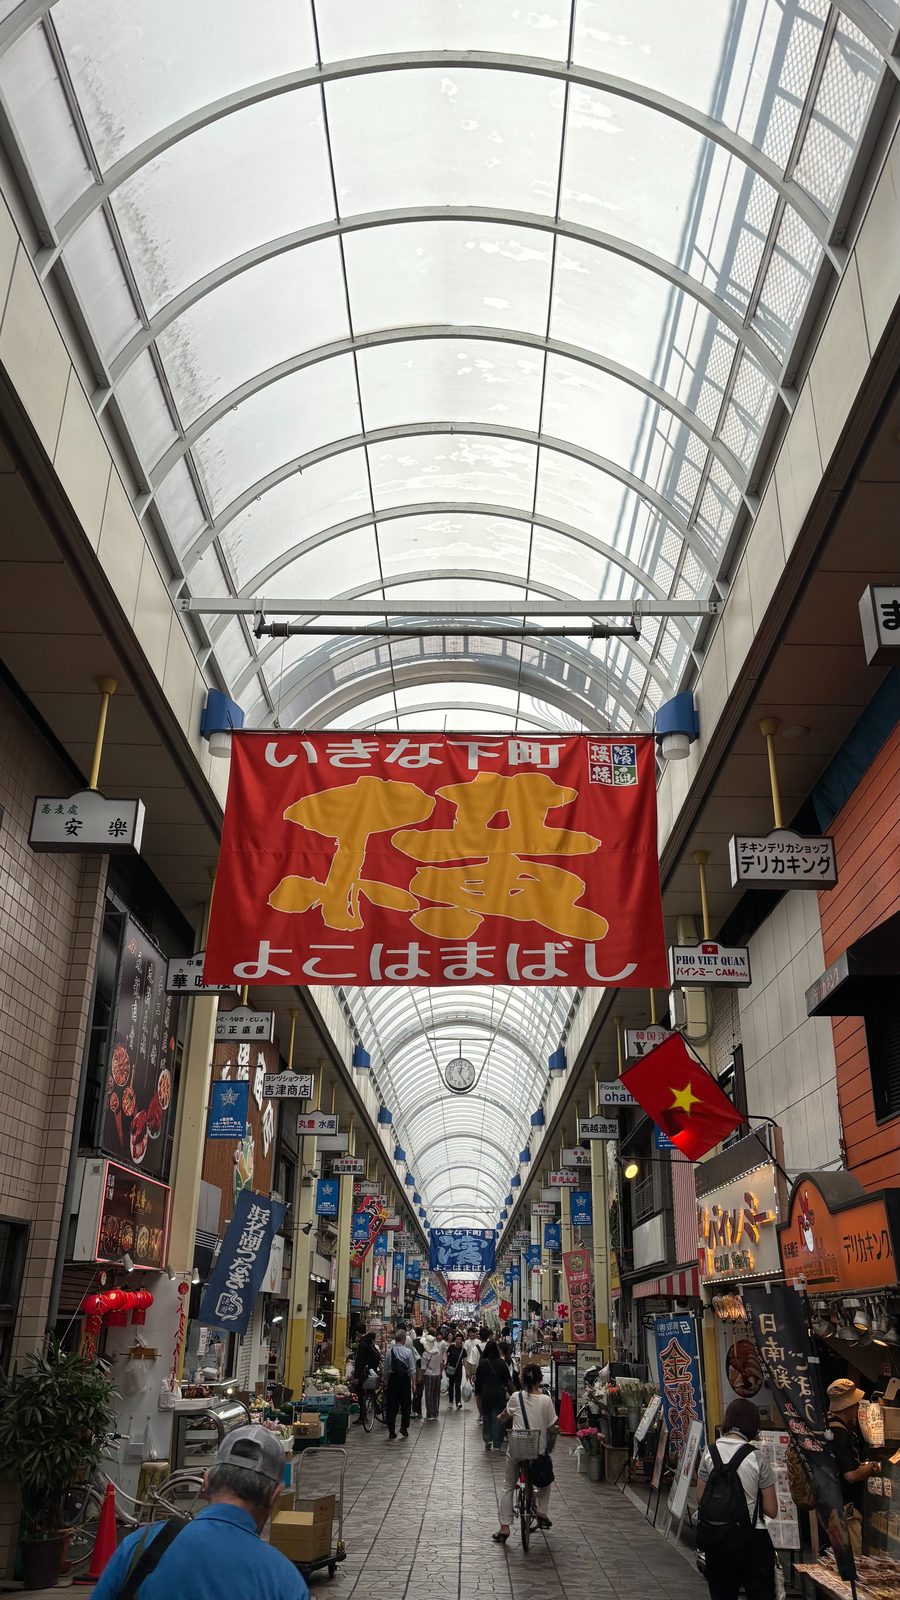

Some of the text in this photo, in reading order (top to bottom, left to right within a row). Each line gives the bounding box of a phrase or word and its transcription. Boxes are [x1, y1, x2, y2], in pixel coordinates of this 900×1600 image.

[264, 738, 567, 770] いきな下町
[64, 817, 128, 838] 安楽
[739, 842, 829, 854] チキンデリカショップ
[740, 855, 831, 875] デリカキング
[232, 939, 639, 982] よこはまばし
[676, 955, 746, 967] PHO VIET QUAN
[676, 967, 714, 976] バインミー
[171, 973, 230, 989] 華味
[264, 1083, 310, 1096] 吉津商店
[605, 1091, 634, 1102] ohan
[298, 1119, 336, 1129] 丸豊 水産
[580, 1123, 617, 1134] 西越造型
[225, 1203, 271, 1290] 浜名湖うなぎ
[842, 1229, 893, 1265] デリカキング
[433, 1264, 491, 1272] よこはまばし
